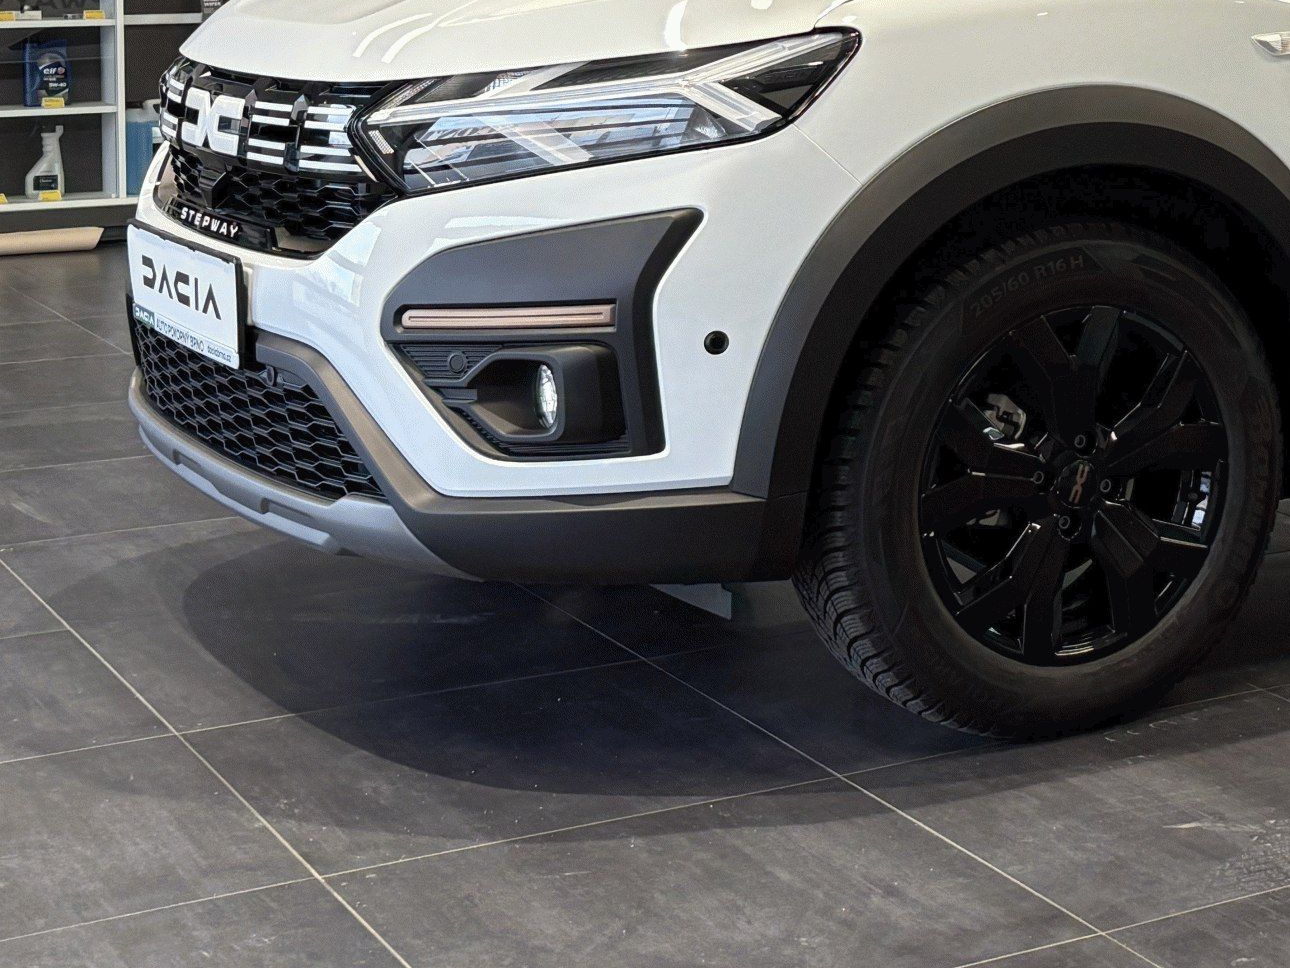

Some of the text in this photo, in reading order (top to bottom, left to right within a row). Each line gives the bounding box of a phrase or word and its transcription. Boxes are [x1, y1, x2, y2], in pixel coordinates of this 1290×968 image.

[180, 206, 239, 238] STEPWAY
[141, 254, 222, 321] DACIA
[969, 270, 1030, 318] 205/60
[1034, 257, 1068, 281] R16
